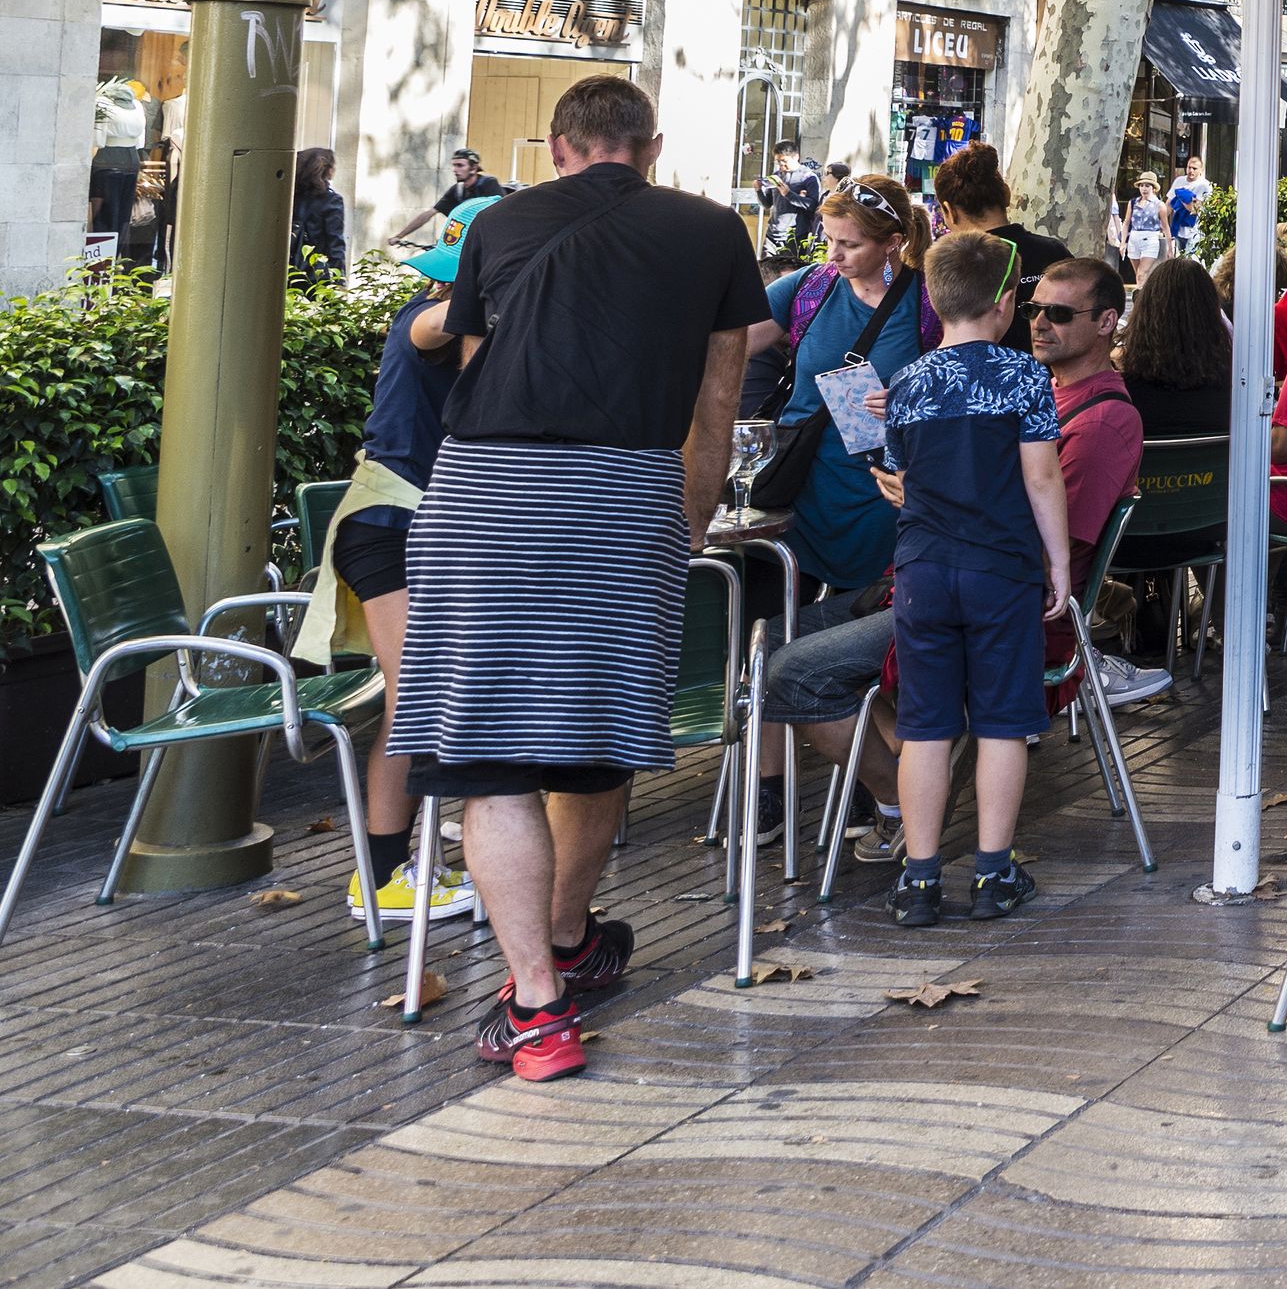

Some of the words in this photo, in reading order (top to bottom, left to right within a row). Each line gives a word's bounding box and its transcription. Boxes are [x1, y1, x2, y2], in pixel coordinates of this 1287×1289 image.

[943, 17, 955, 27] DE
[960, 20, 988, 31] REGAL
[913, 28, 969, 59] LICEU
[949, 127, 965, 142] 10
